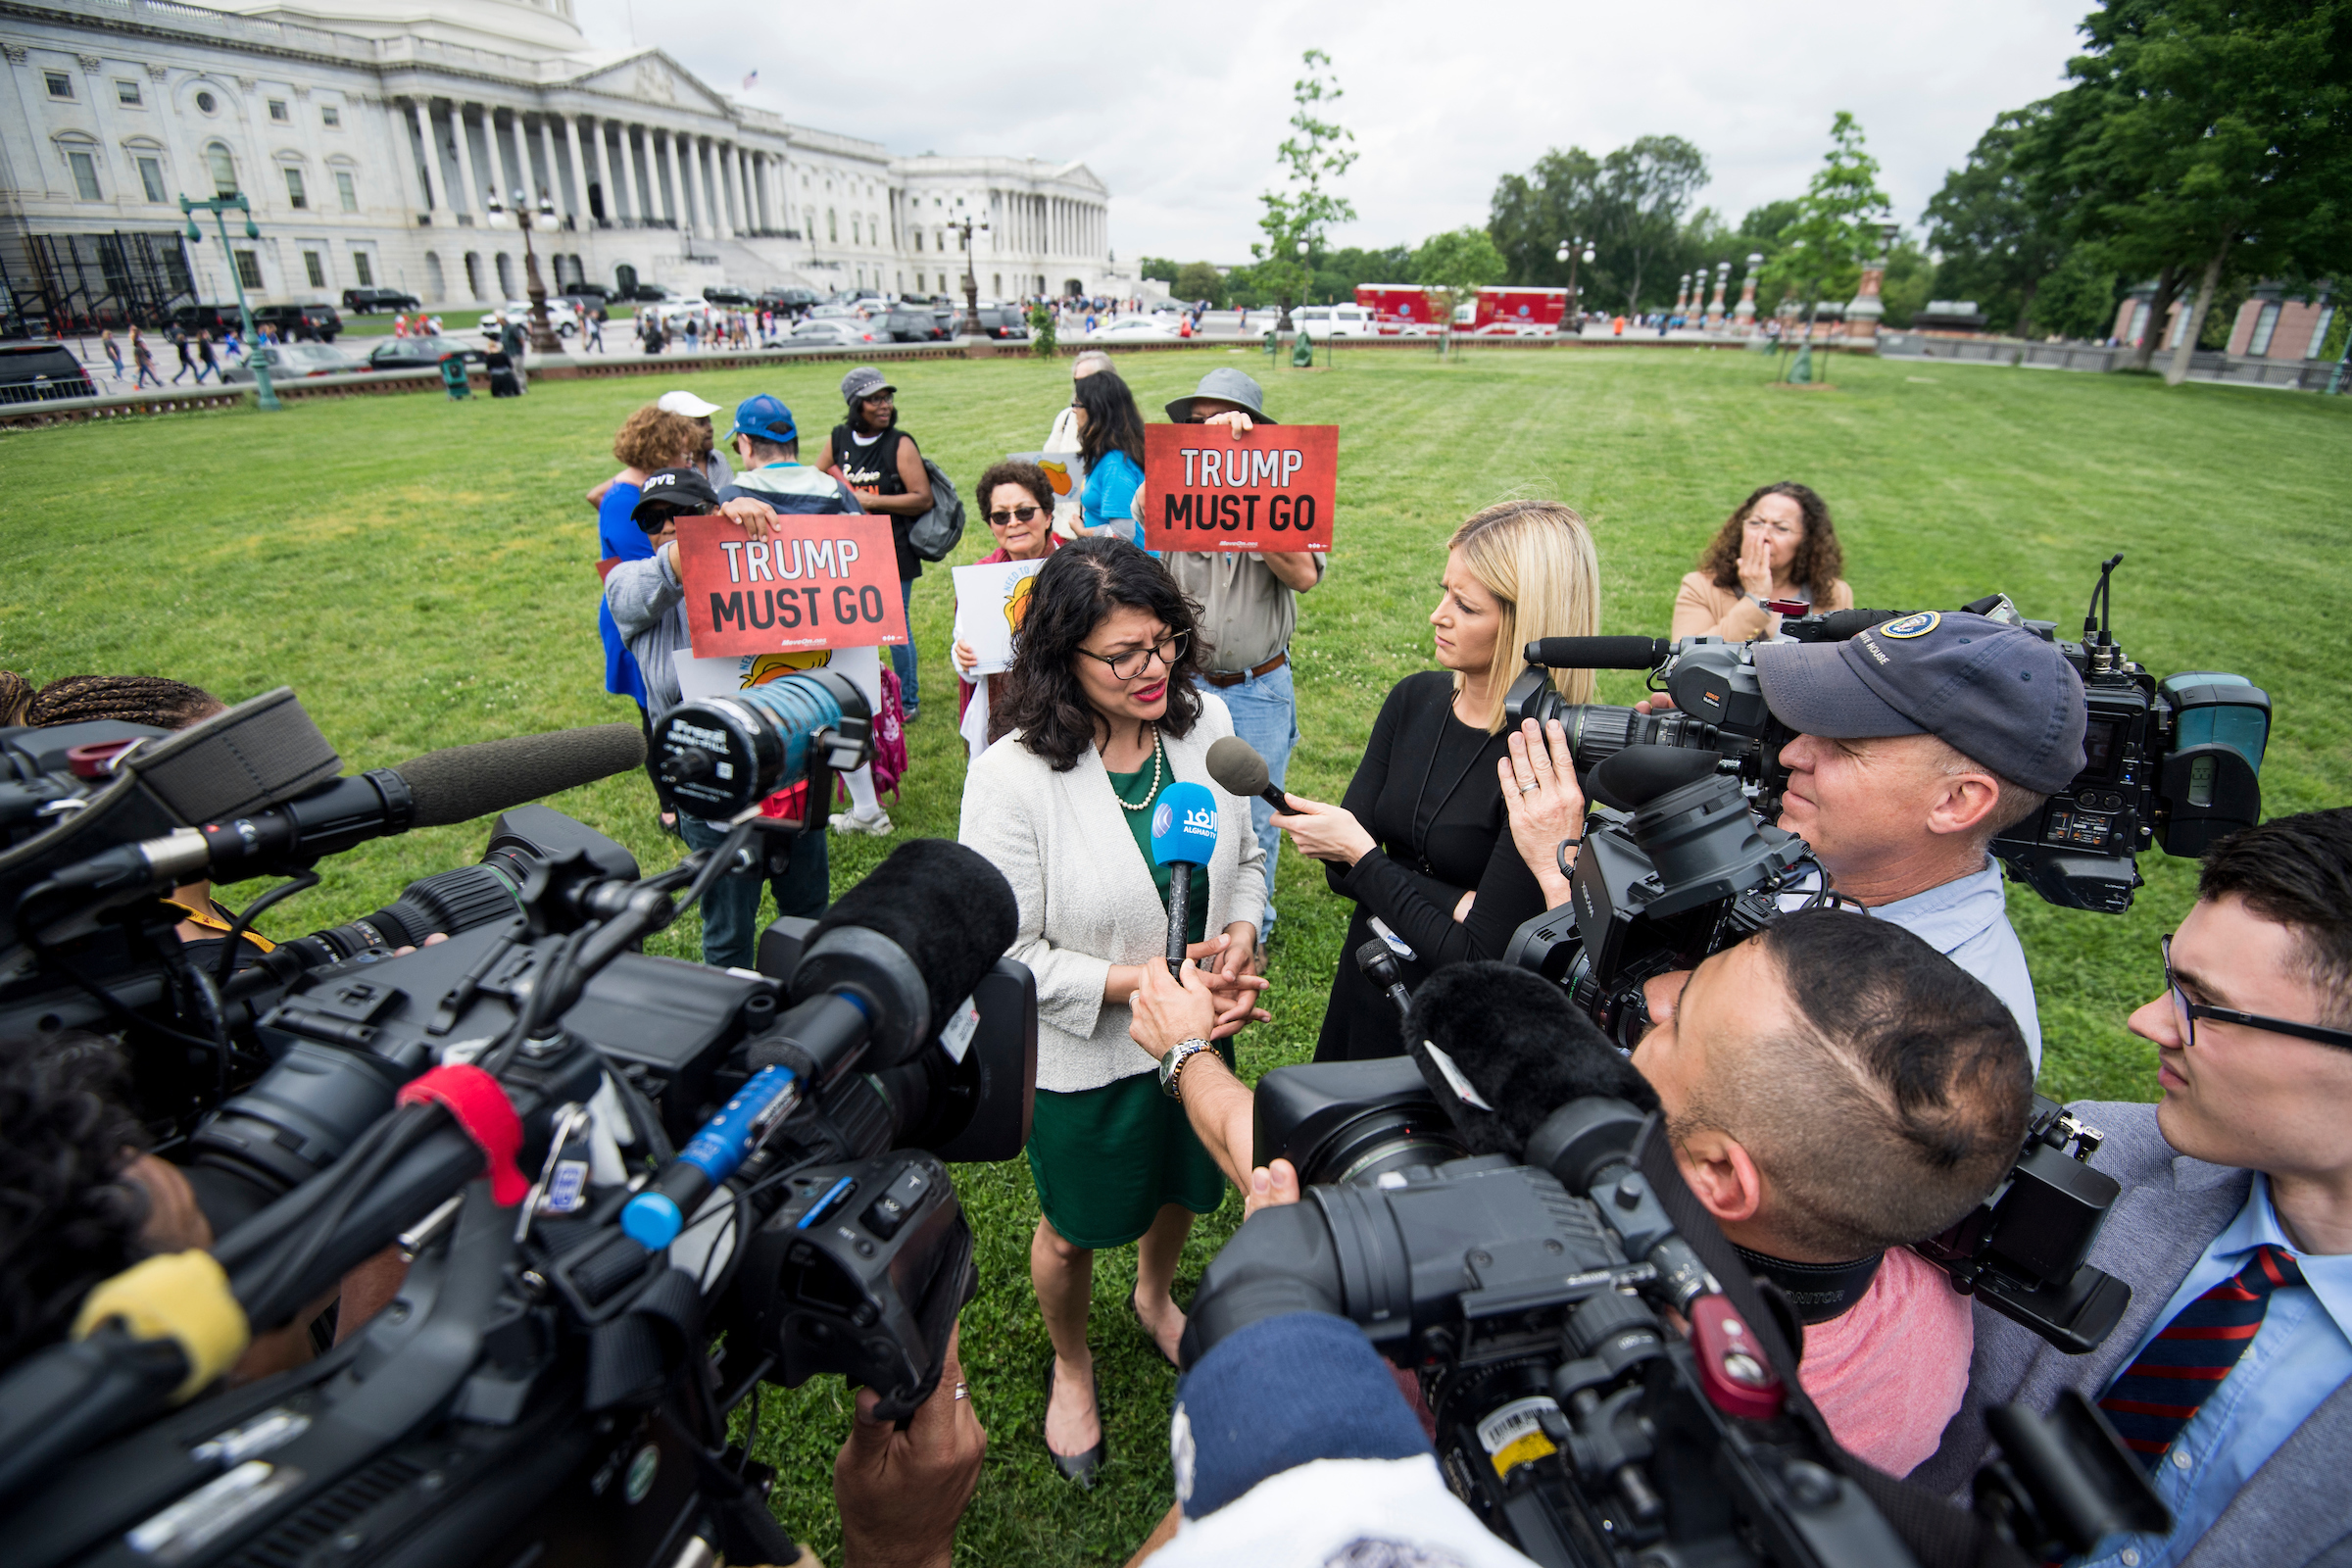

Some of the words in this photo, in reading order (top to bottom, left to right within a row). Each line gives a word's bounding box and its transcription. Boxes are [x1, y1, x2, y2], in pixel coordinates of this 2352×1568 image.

[1180, 448, 1303, 488] TRUMP
[643, 473, 676, 493] LOVE
[1165, 493, 1261, 531] MUST
[1269, 494, 1316, 531] GO
[719, 539, 859, 583] TRUMP
[1004, 570, 1019, 592] NEED
[1019, 565, 1030, 576] TO
[710, 587, 821, 633] MUST
[833, 584, 884, 625] GO
[1866, 640, 1890, 665] HOUSE
[1183, 826, 1210, 837] ALGHAD
[907, 1175, 921, 1189] T
[884, 1199, 900, 1212] W
[1784, 1289, 1845, 1304] ONITOR
